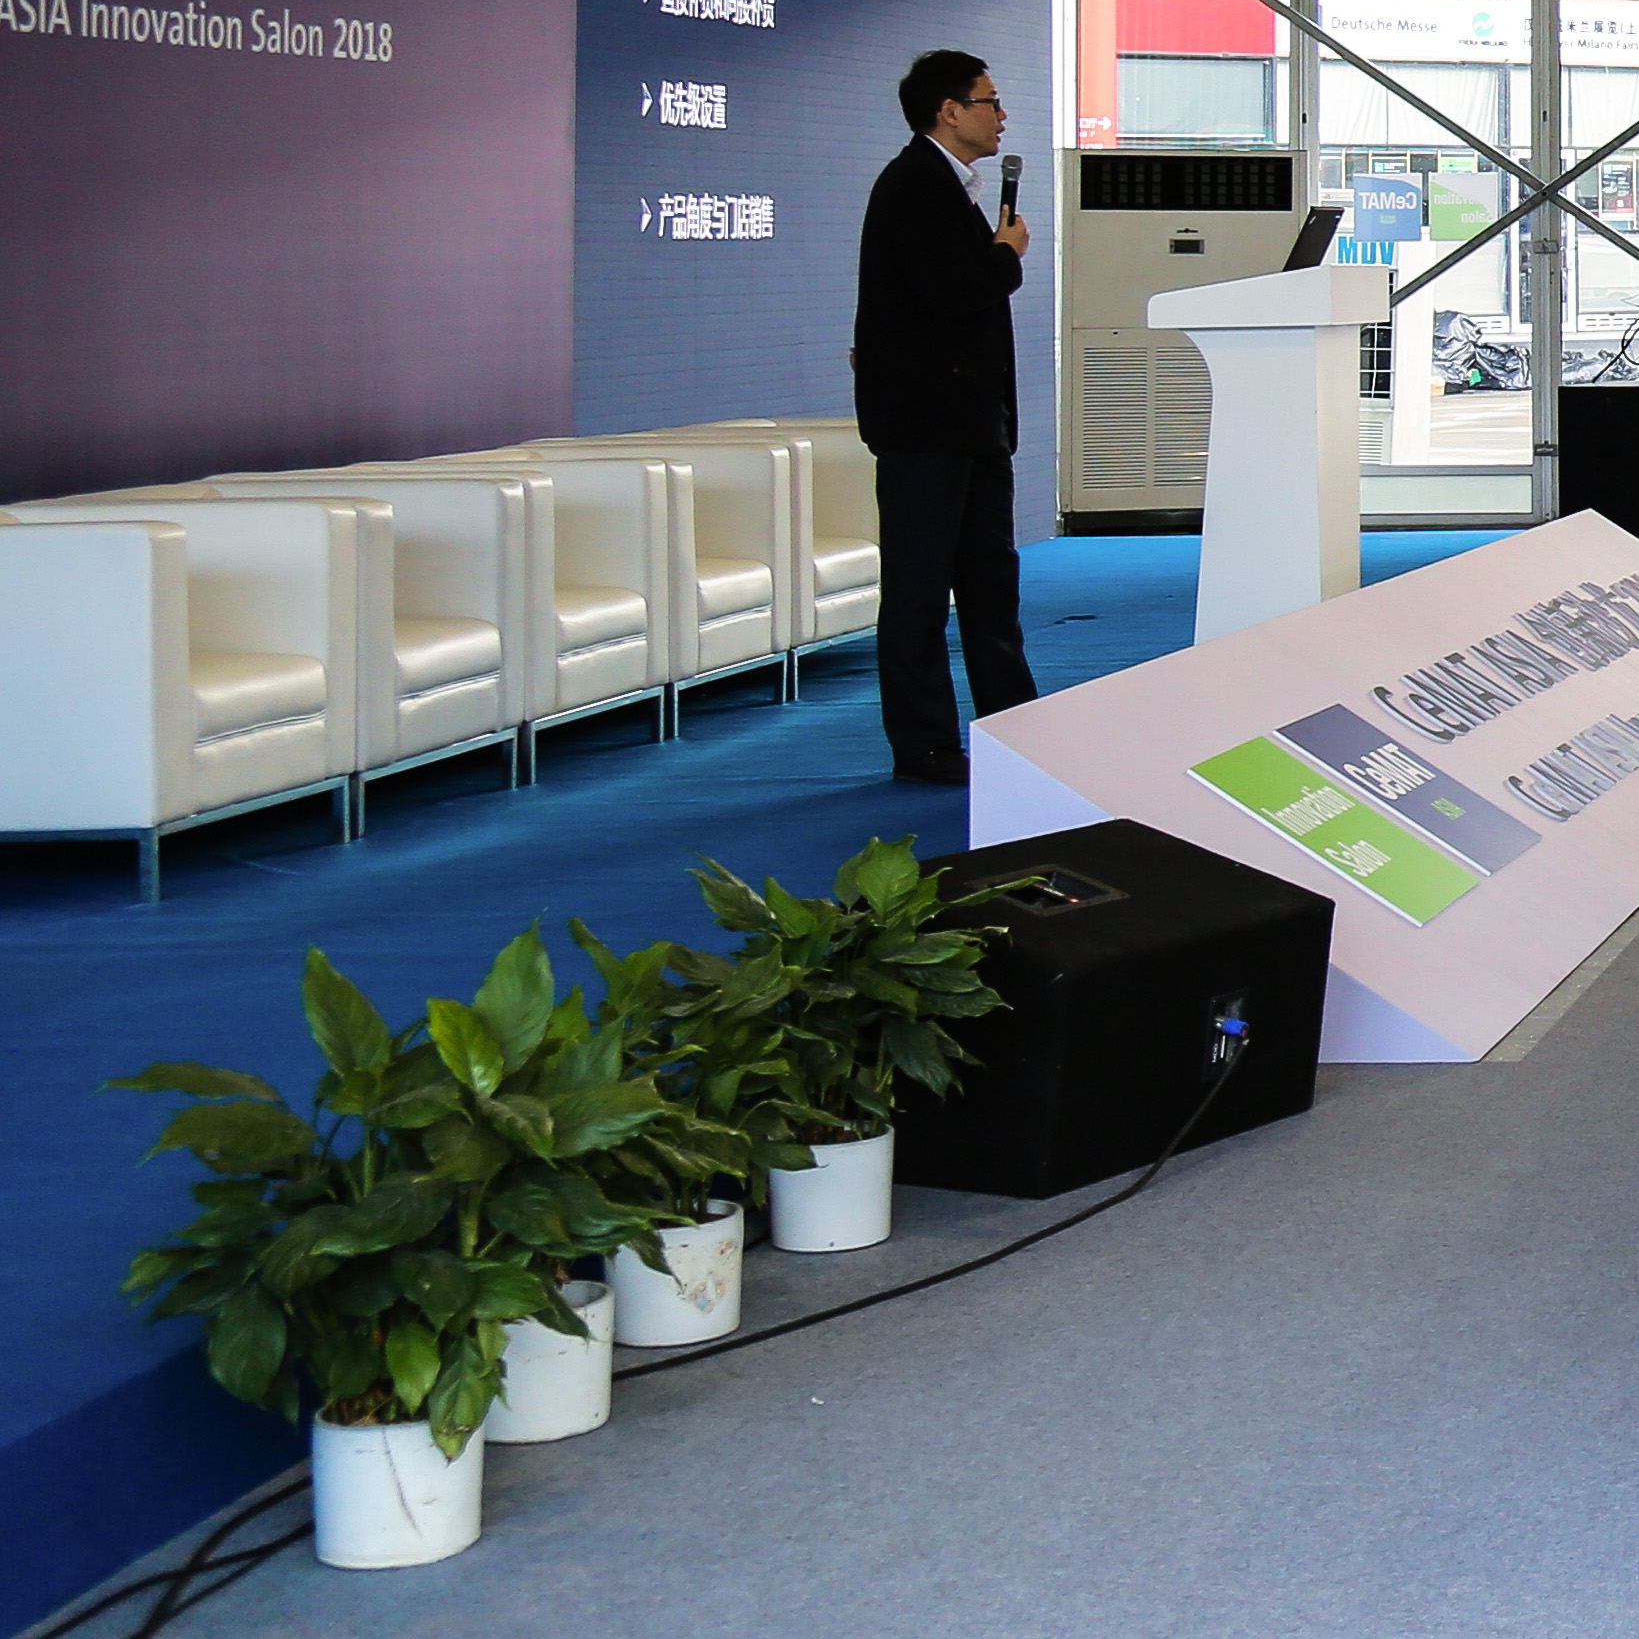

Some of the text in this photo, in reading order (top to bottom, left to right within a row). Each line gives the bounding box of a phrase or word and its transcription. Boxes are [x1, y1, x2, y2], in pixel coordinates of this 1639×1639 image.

[251, 8, 324, 59] Salon
[333, 18, 395, 63] 2018
[1331, 16, 1438, 33] Deutsche Messe
[659, 80, 728, 129] 优先级设置
[658, 192, 775, 240] 产品角度与门店销售
[1370, 652, 1523, 744] CeMAT
[1466, 629, 1580, 699] ASIA
[1343, 742, 1437, 801] CeMAT
[1503, 743, 1618, 823] CeMAT
[1261, 785, 1356, 837] Innovation
[1324, 840, 1392, 877] Salon
